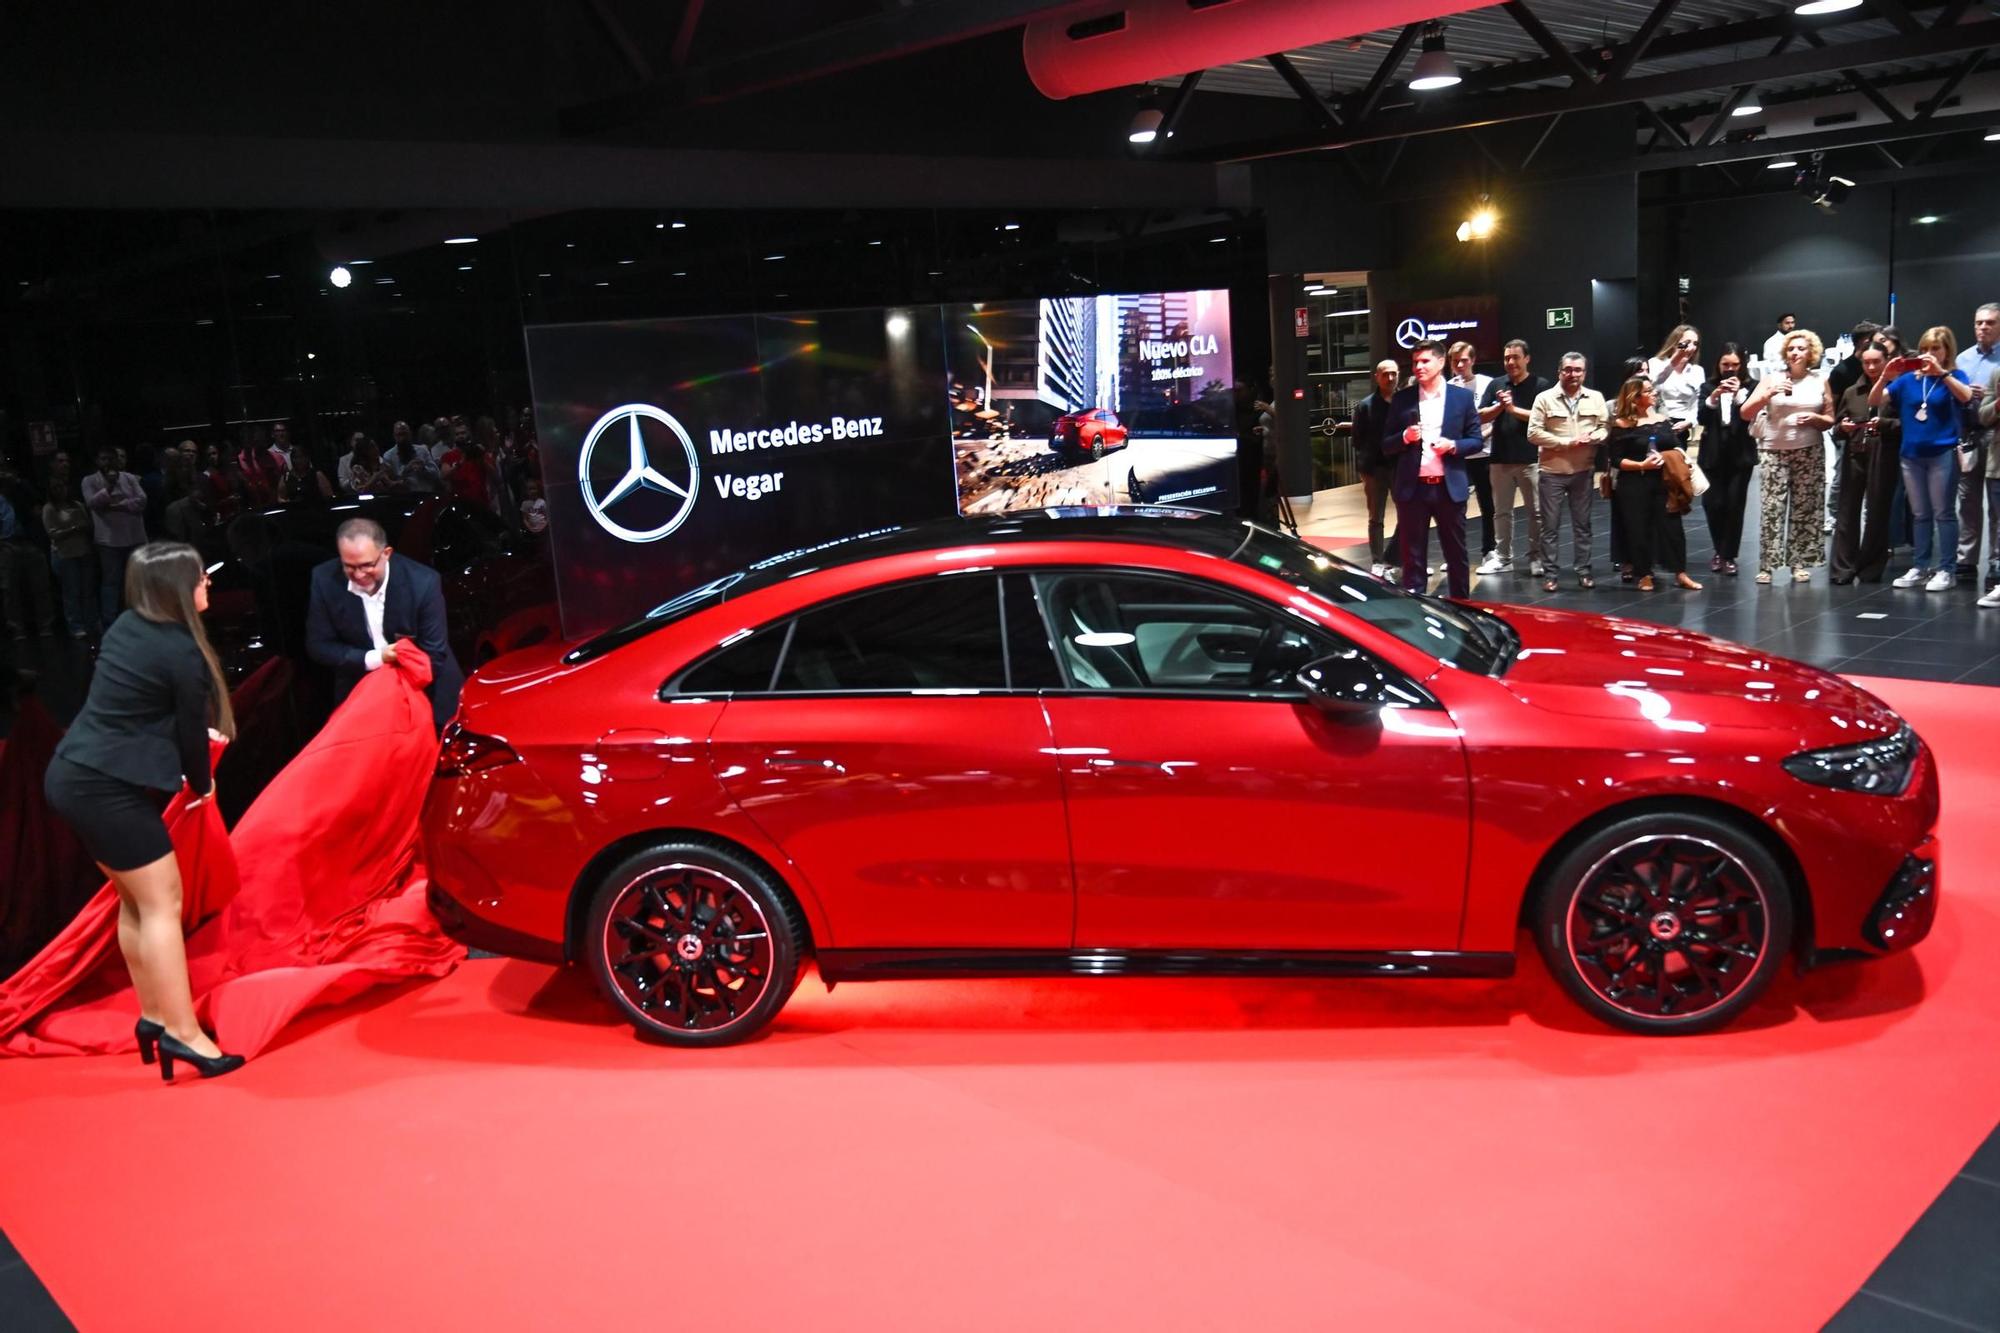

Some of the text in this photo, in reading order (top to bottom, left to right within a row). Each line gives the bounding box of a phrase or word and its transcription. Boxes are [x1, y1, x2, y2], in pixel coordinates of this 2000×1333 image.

[1139, 334, 1218, 361] Nuevo CLA
[1151, 367, 1204, 381] 100% eléctrico
[710, 417, 883, 454] Mercedes-Benz
[714, 472, 784, 500] Vegar
